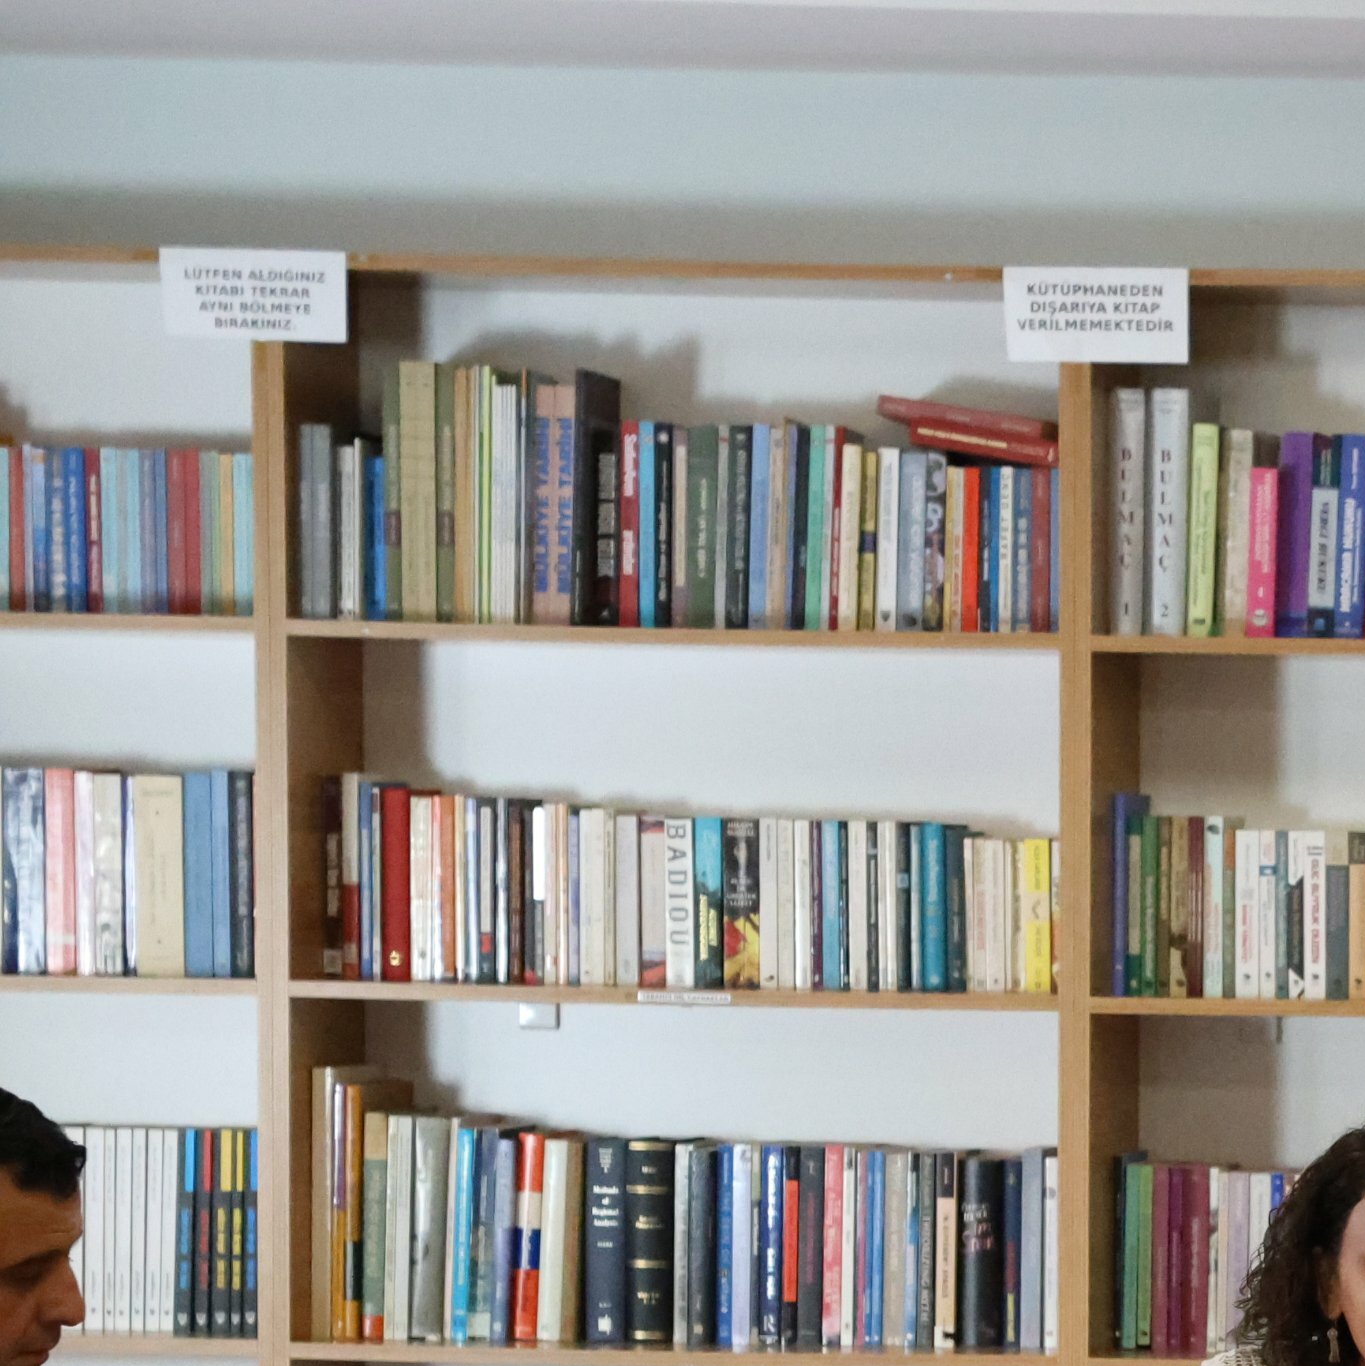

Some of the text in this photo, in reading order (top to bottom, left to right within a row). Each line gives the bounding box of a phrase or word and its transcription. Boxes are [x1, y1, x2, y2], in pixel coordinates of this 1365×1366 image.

[184, 267, 326, 284] LÜTFEN ALDIĞINIZ
[195, 284, 310, 298] KİTABI TEKRAR
[1027, 281, 1163, 297] KÜTÜPHANEDEN
[199, 300, 311, 315] AYNI BÖLMEYE
[1030, 301, 1161, 316] DIŞARIYA KİTAP
[1017, 317, 1174, 332] VERİLMEMEKTEDİR
[1157, 448, 1174, 618] BULMAÇ 2
[667, 823, 689, 945] BADIOU
